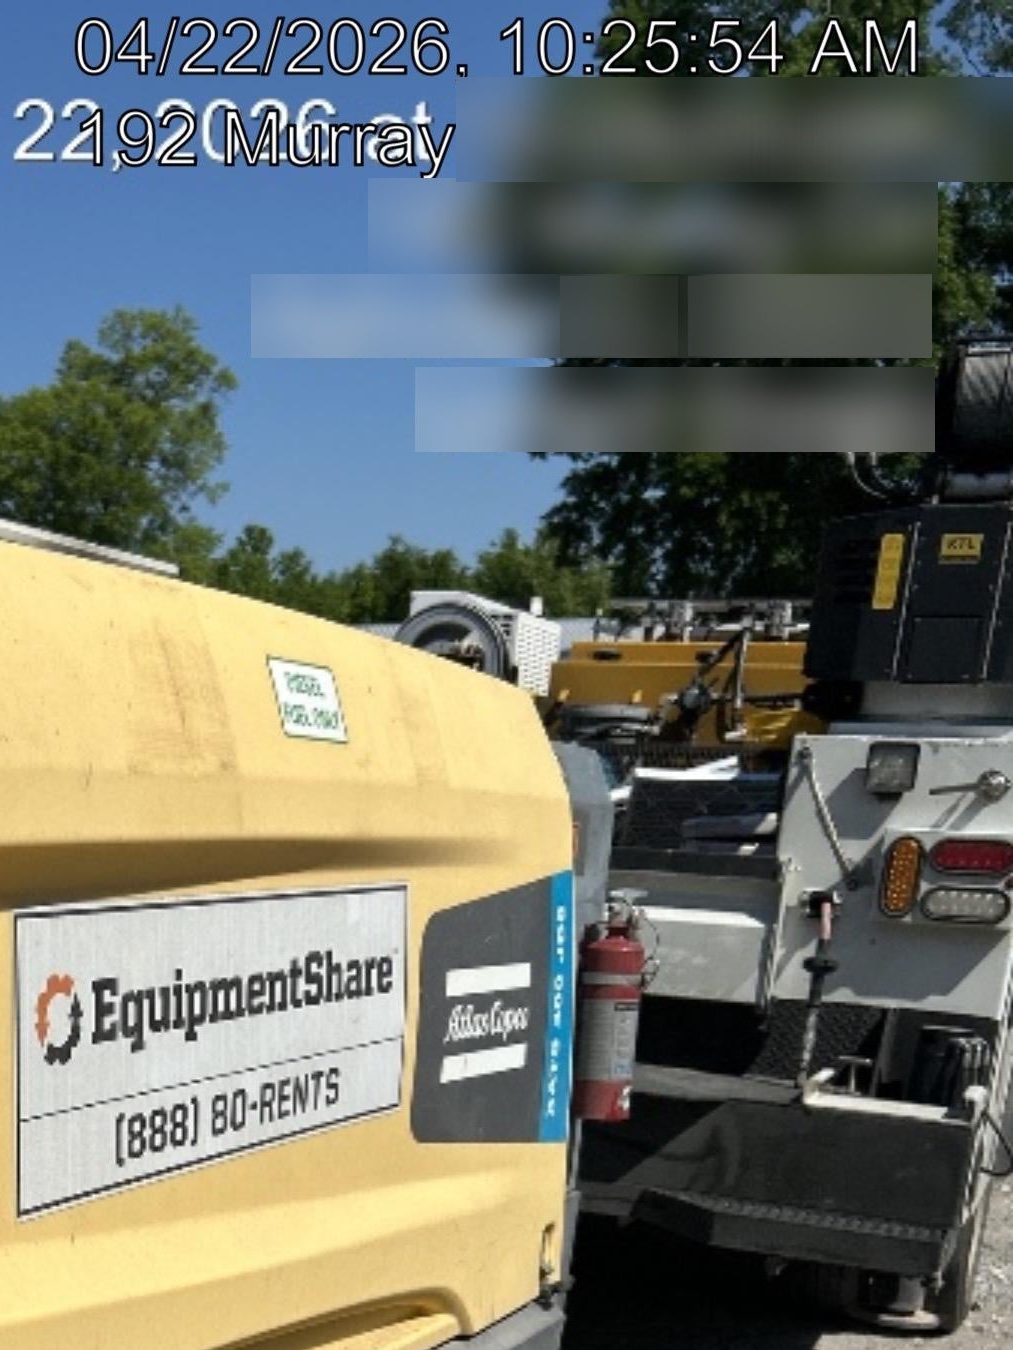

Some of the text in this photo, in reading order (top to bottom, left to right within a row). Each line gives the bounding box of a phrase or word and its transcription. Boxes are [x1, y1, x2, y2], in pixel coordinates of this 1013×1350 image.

[91, 949, 394, 1053] EquipmentShare
[442, 999, 529, 1044] Atlas Copco
[114, 1067, 341, 1167] (888) 80-RENTS
